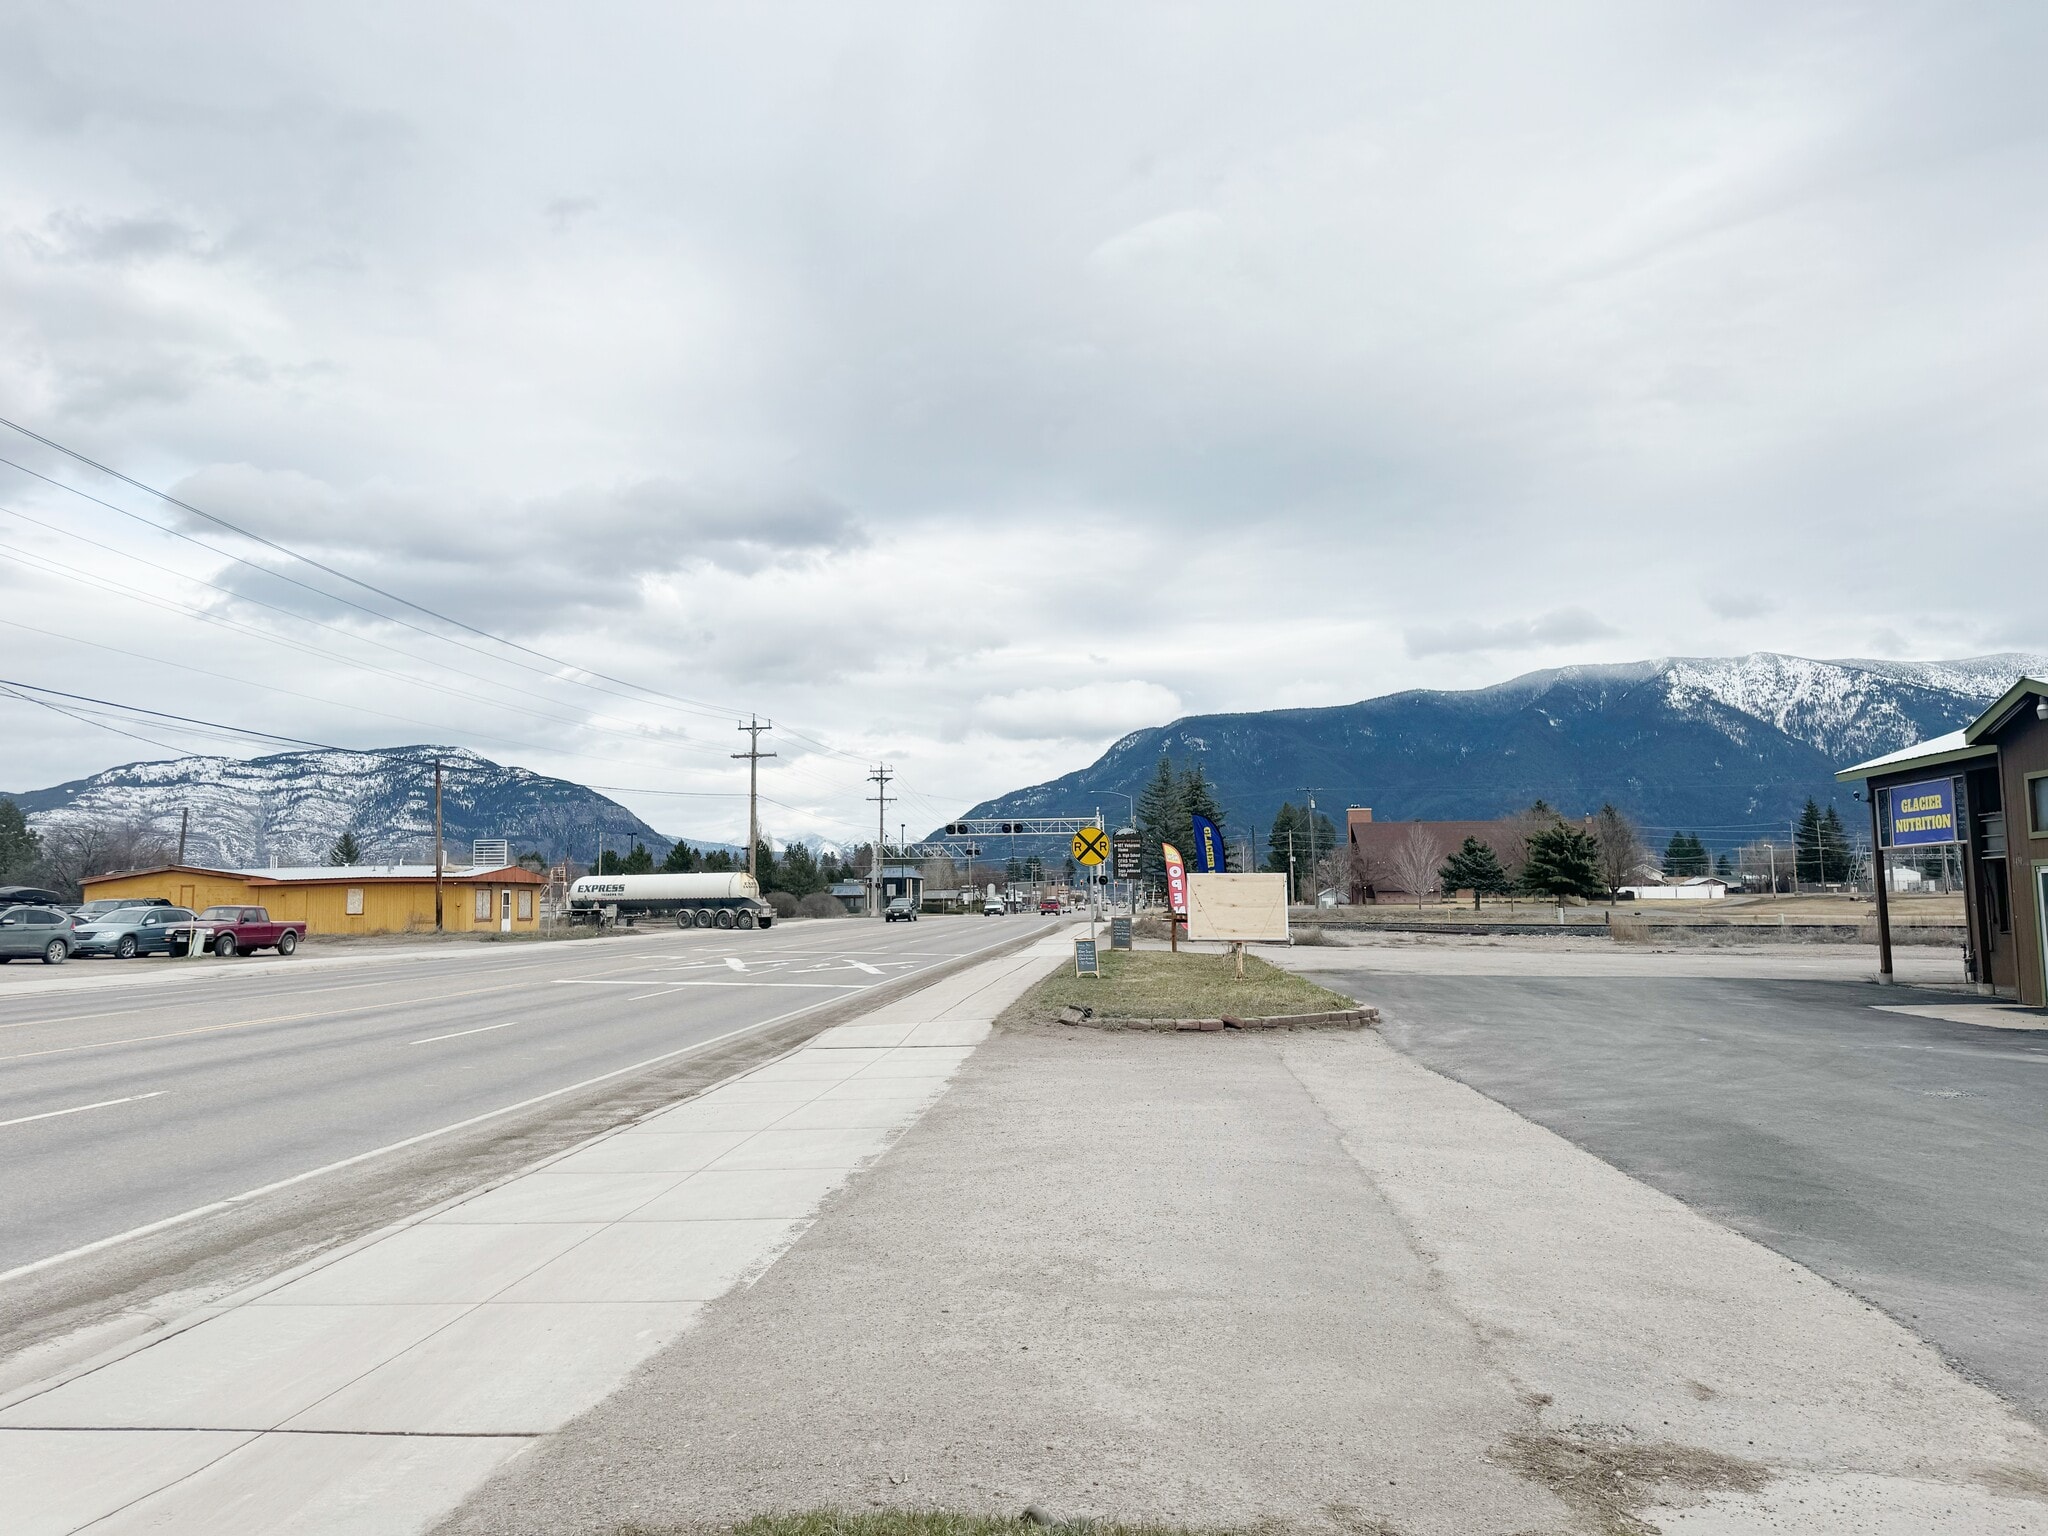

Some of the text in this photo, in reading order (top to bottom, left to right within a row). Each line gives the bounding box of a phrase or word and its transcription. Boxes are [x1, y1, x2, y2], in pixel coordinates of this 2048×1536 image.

[1900, 794, 1942, 813] GLACIER
[1896, 814, 1952, 833] NUTRITION
[1074, 842, 1107, 852] R R
[1203, 826, 1215, 868] GLACIER
[577, 884, 626, 893] EXPRESS
